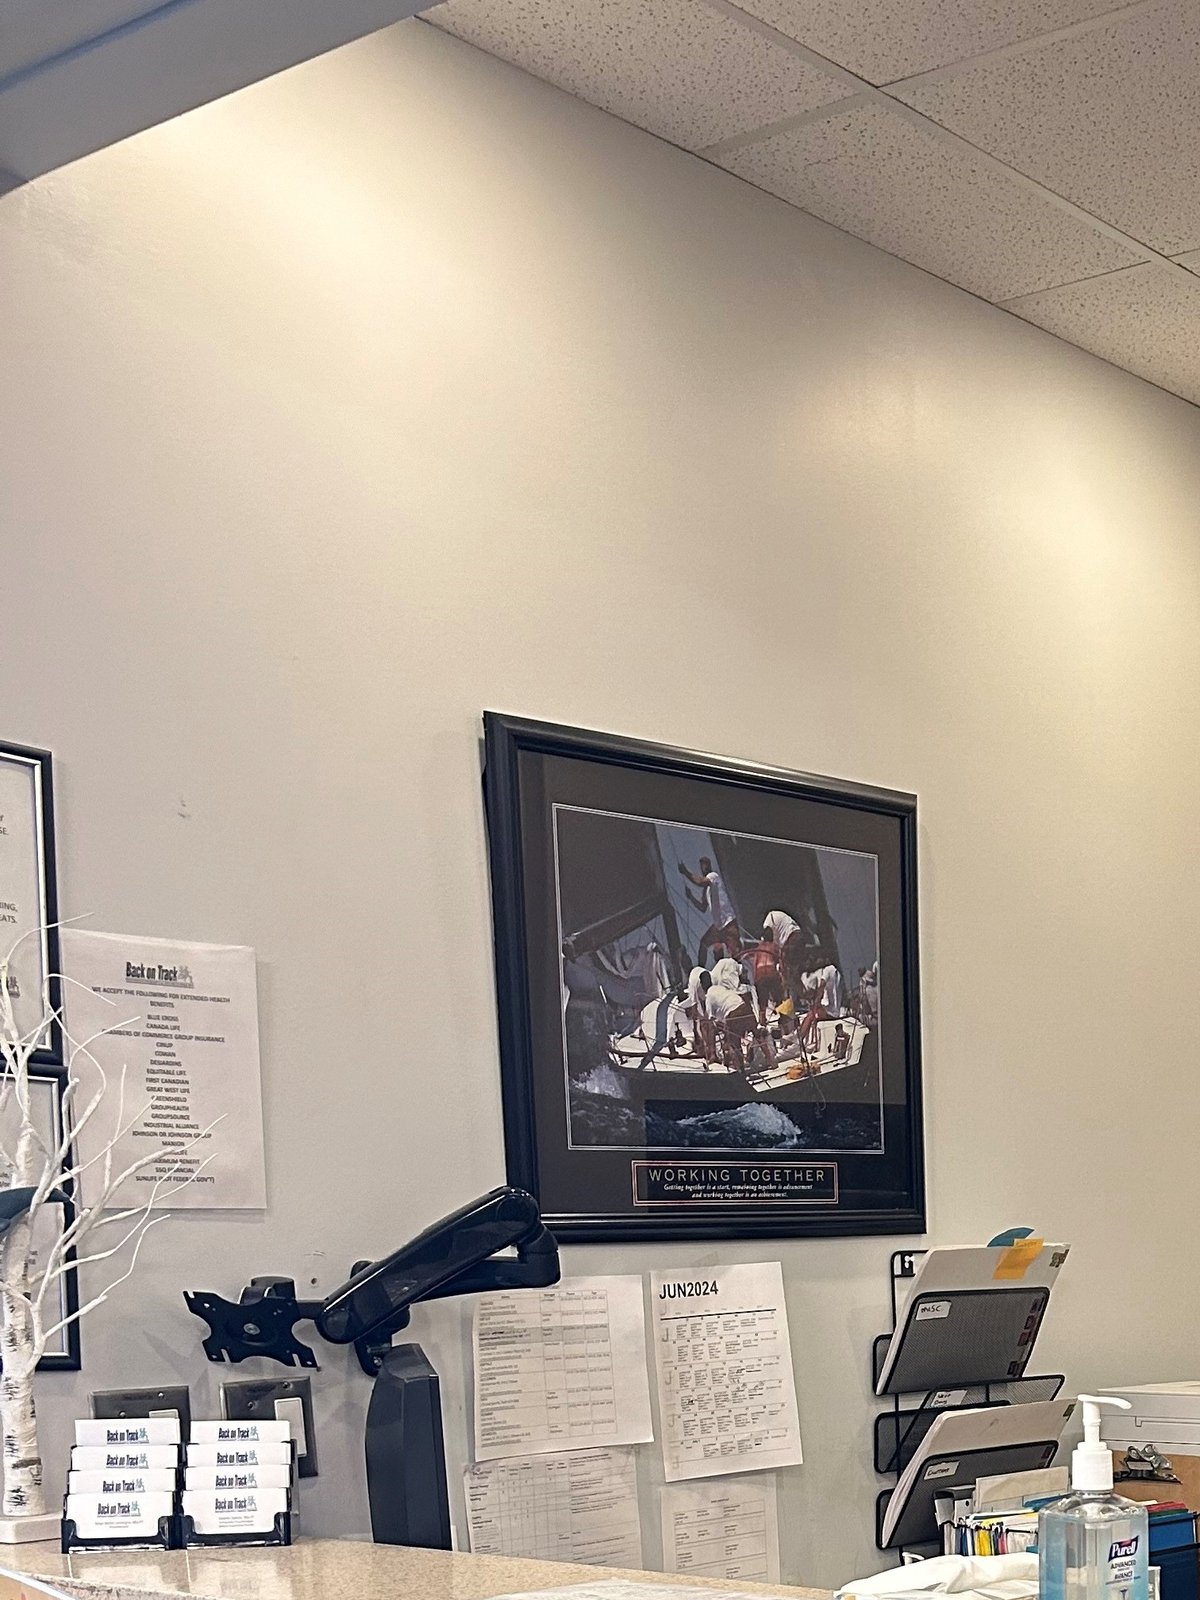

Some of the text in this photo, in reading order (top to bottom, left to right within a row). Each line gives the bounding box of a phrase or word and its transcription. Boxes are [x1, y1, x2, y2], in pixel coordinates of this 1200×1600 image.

[126, 961, 178, 981] Back on Track
[103, 987, 122, 996] ACCEPT
[136, 990, 168, 999] FOLLOWING
[181, 994, 209, 1002] EXTENDED
[149, 1000, 175, 1009] BENEFITS
[146, 1023, 169, 1031] CANADA
[142, 1032, 173, 1040] COMMERCE
[195, 1035, 225, 1043] INSURANCE
[146, 1068, 175, 1076] EQUITABLE
[161, 1078, 190, 1086] CANADIAN
[150, 1104, 190, 1112] GROUPHEALTH
[151, 1113, 190, 1121] GROUPSOURCE
[143, 1122, 174, 1130] INDUSTRIAL
[132, 1130, 158, 1138] JOHNSON
[648, 1169, 824, 1182] WORKING TOGETHER
[663, 1183, 684, 1192] Getting
[685, 1183, 705, 1192] together
[731, 1184, 757, 1192] remaining
[757, 1184, 777, 1192] together
[703, 1191, 723, 1199] working
[724, 1191, 744, 1199] together
[659, 1280, 719, 1299] JUN2024
[107, 1429, 139, 1441] Back on Track
[218, 1427, 250, 1439] Back on Track
[106, 1454, 139, 1466] Back on Track
[216, 1452, 248, 1463] Back on Track
[103, 1480, 135, 1492] Back on Track
[215, 1474, 247, 1487] Back on Track
[98, 1502, 130, 1515] Back on Track
[215, 1498, 247, 1510] Back on Track
[1110, 1560, 1136, 1569] ADVANCED
